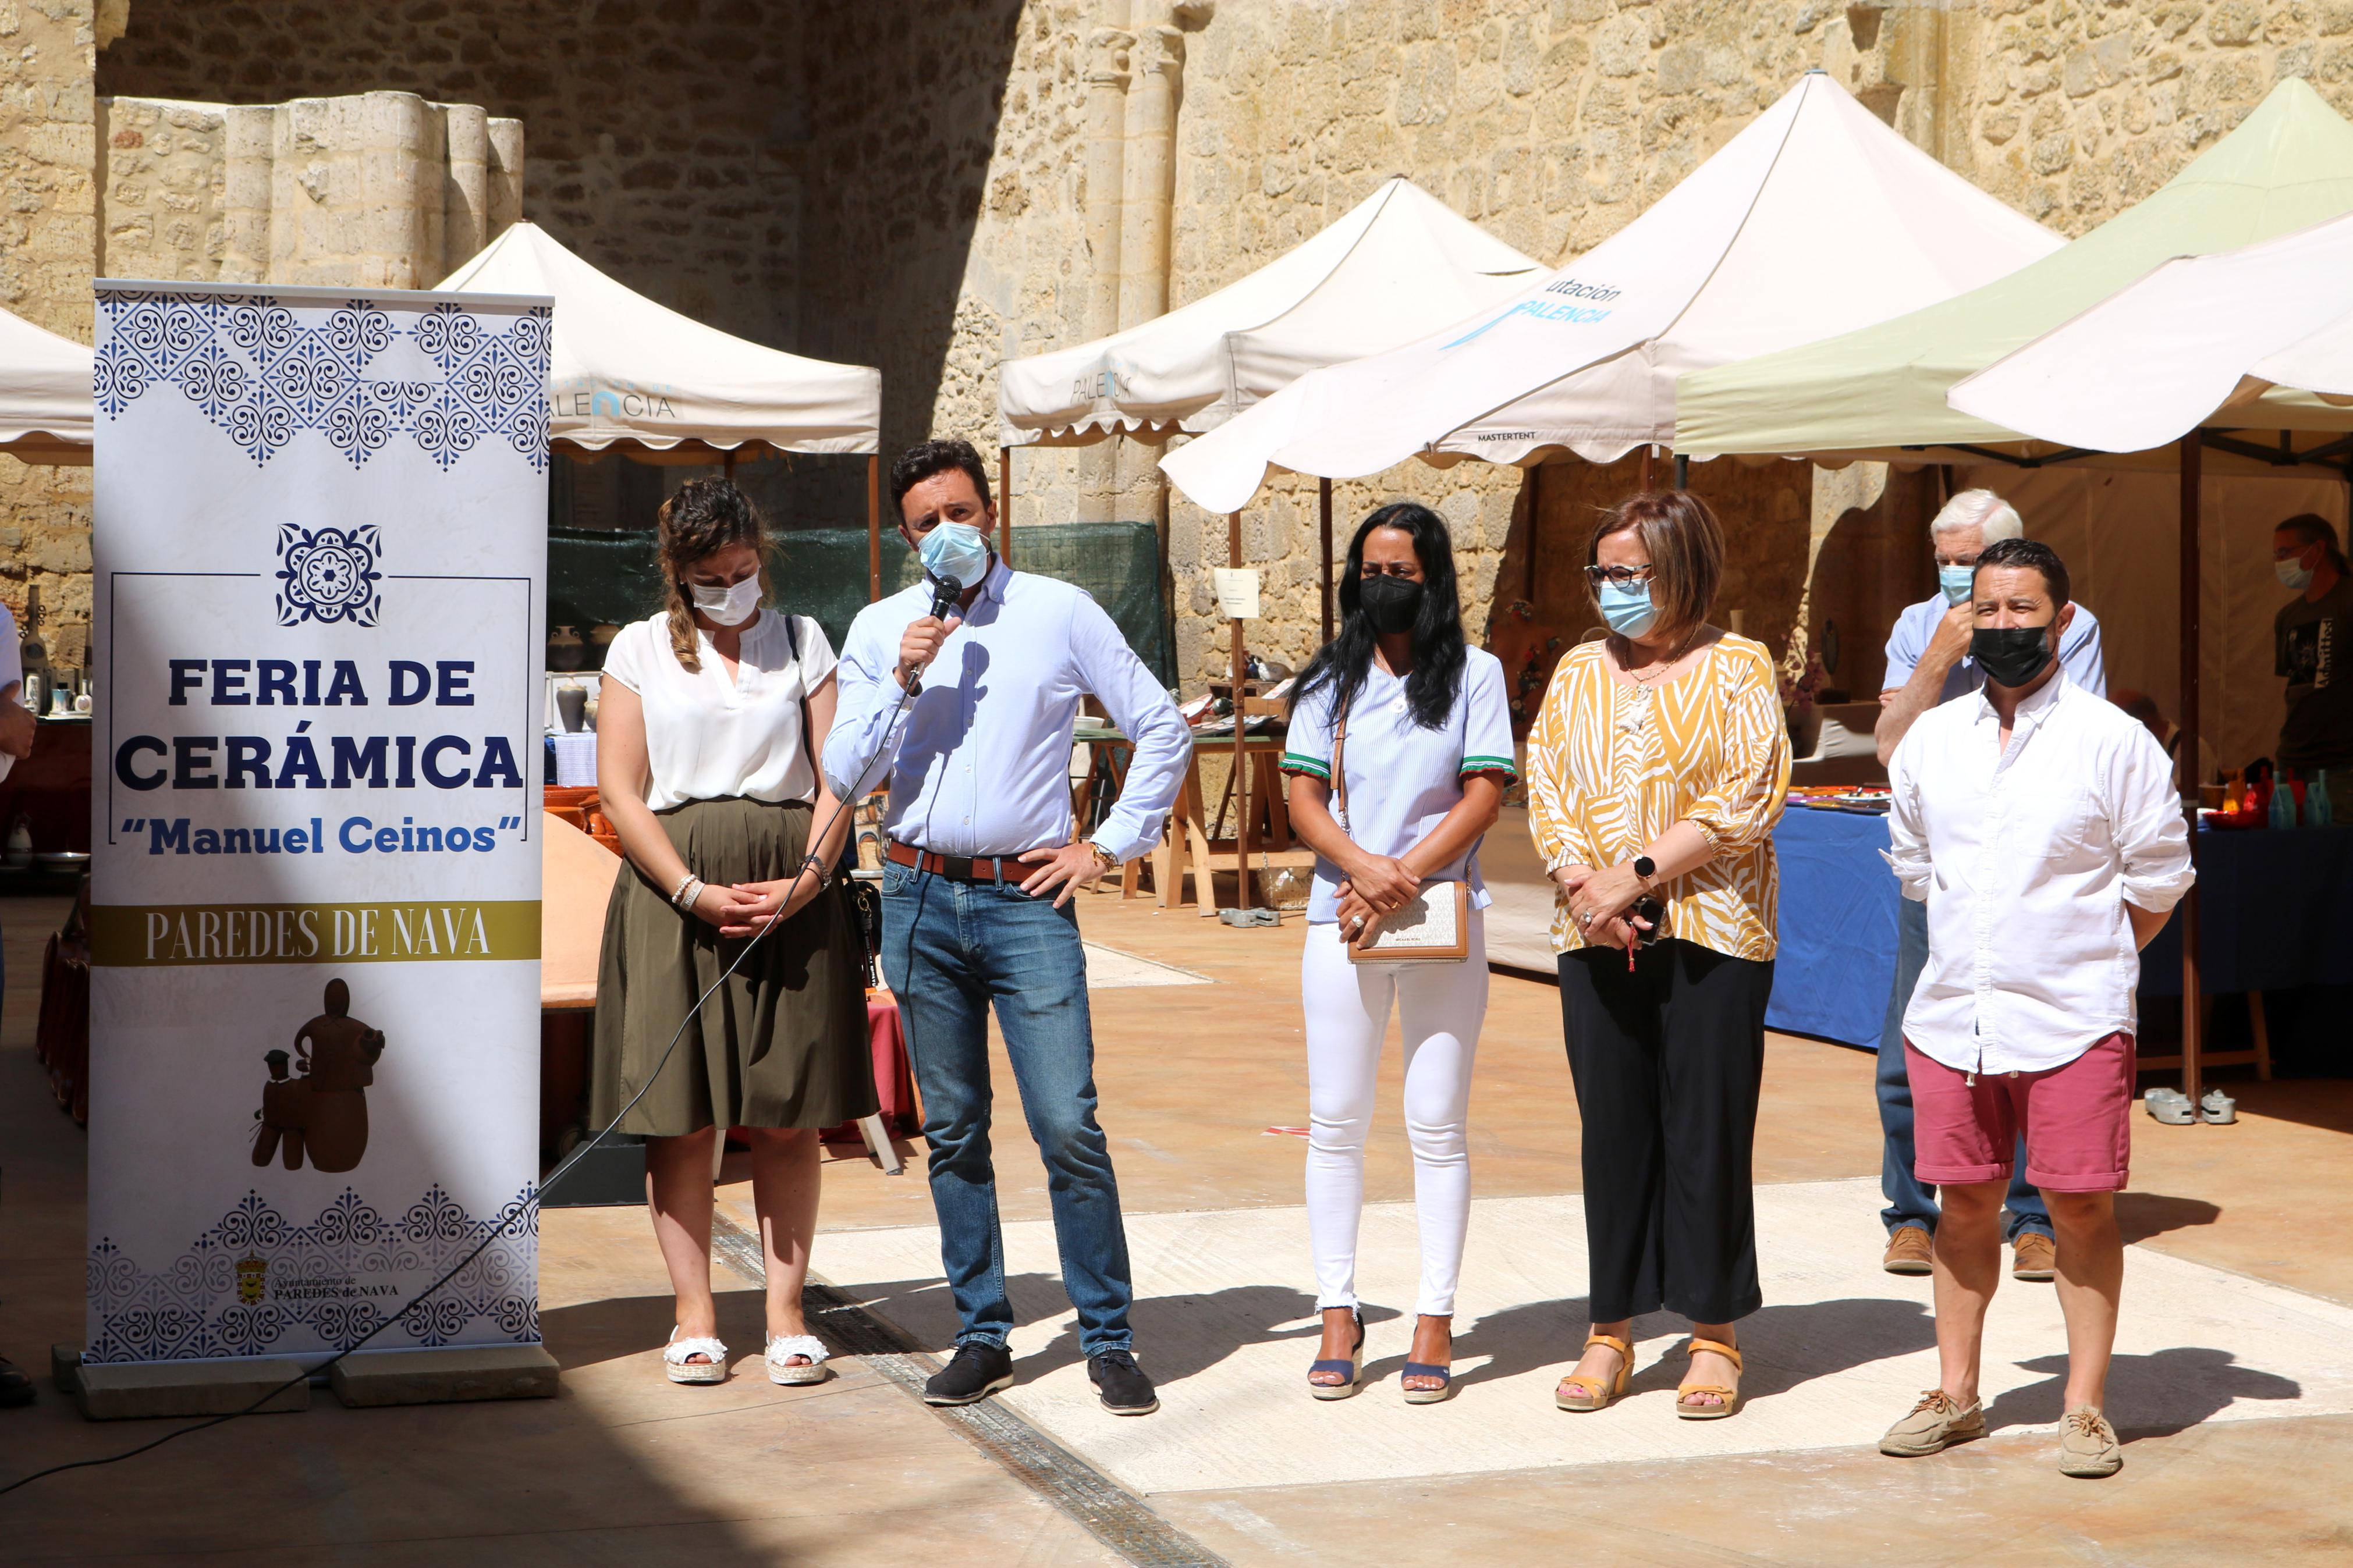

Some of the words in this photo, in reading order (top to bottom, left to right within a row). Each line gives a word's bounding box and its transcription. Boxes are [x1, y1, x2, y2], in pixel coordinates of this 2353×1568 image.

[1520, 300, 1612, 323] PALENCIA
[1478, 432, 1536, 442] MASTERTENT
[2317, 620, 2332, 686] Admitted
[169, 659, 368, 706] FERIA
[388, 660, 474, 706] DE
[115, 720, 523, 790] CERÁMICA
[121, 817, 324, 855] "Manuel
[339, 816, 521, 854] Ceinos"
[145, 910, 319, 960] PAREDES
[332, 909, 379, 956] DE
[391, 908, 491, 955] NAVA
[274, 1288, 339, 1300] PAREDES
[342, 1286, 357, 1297] de
[360, 1285, 399, 1297] NAVA
[275, 1277, 342, 1289] Ayuntamiento
[345, 1276, 356, 1285] de
